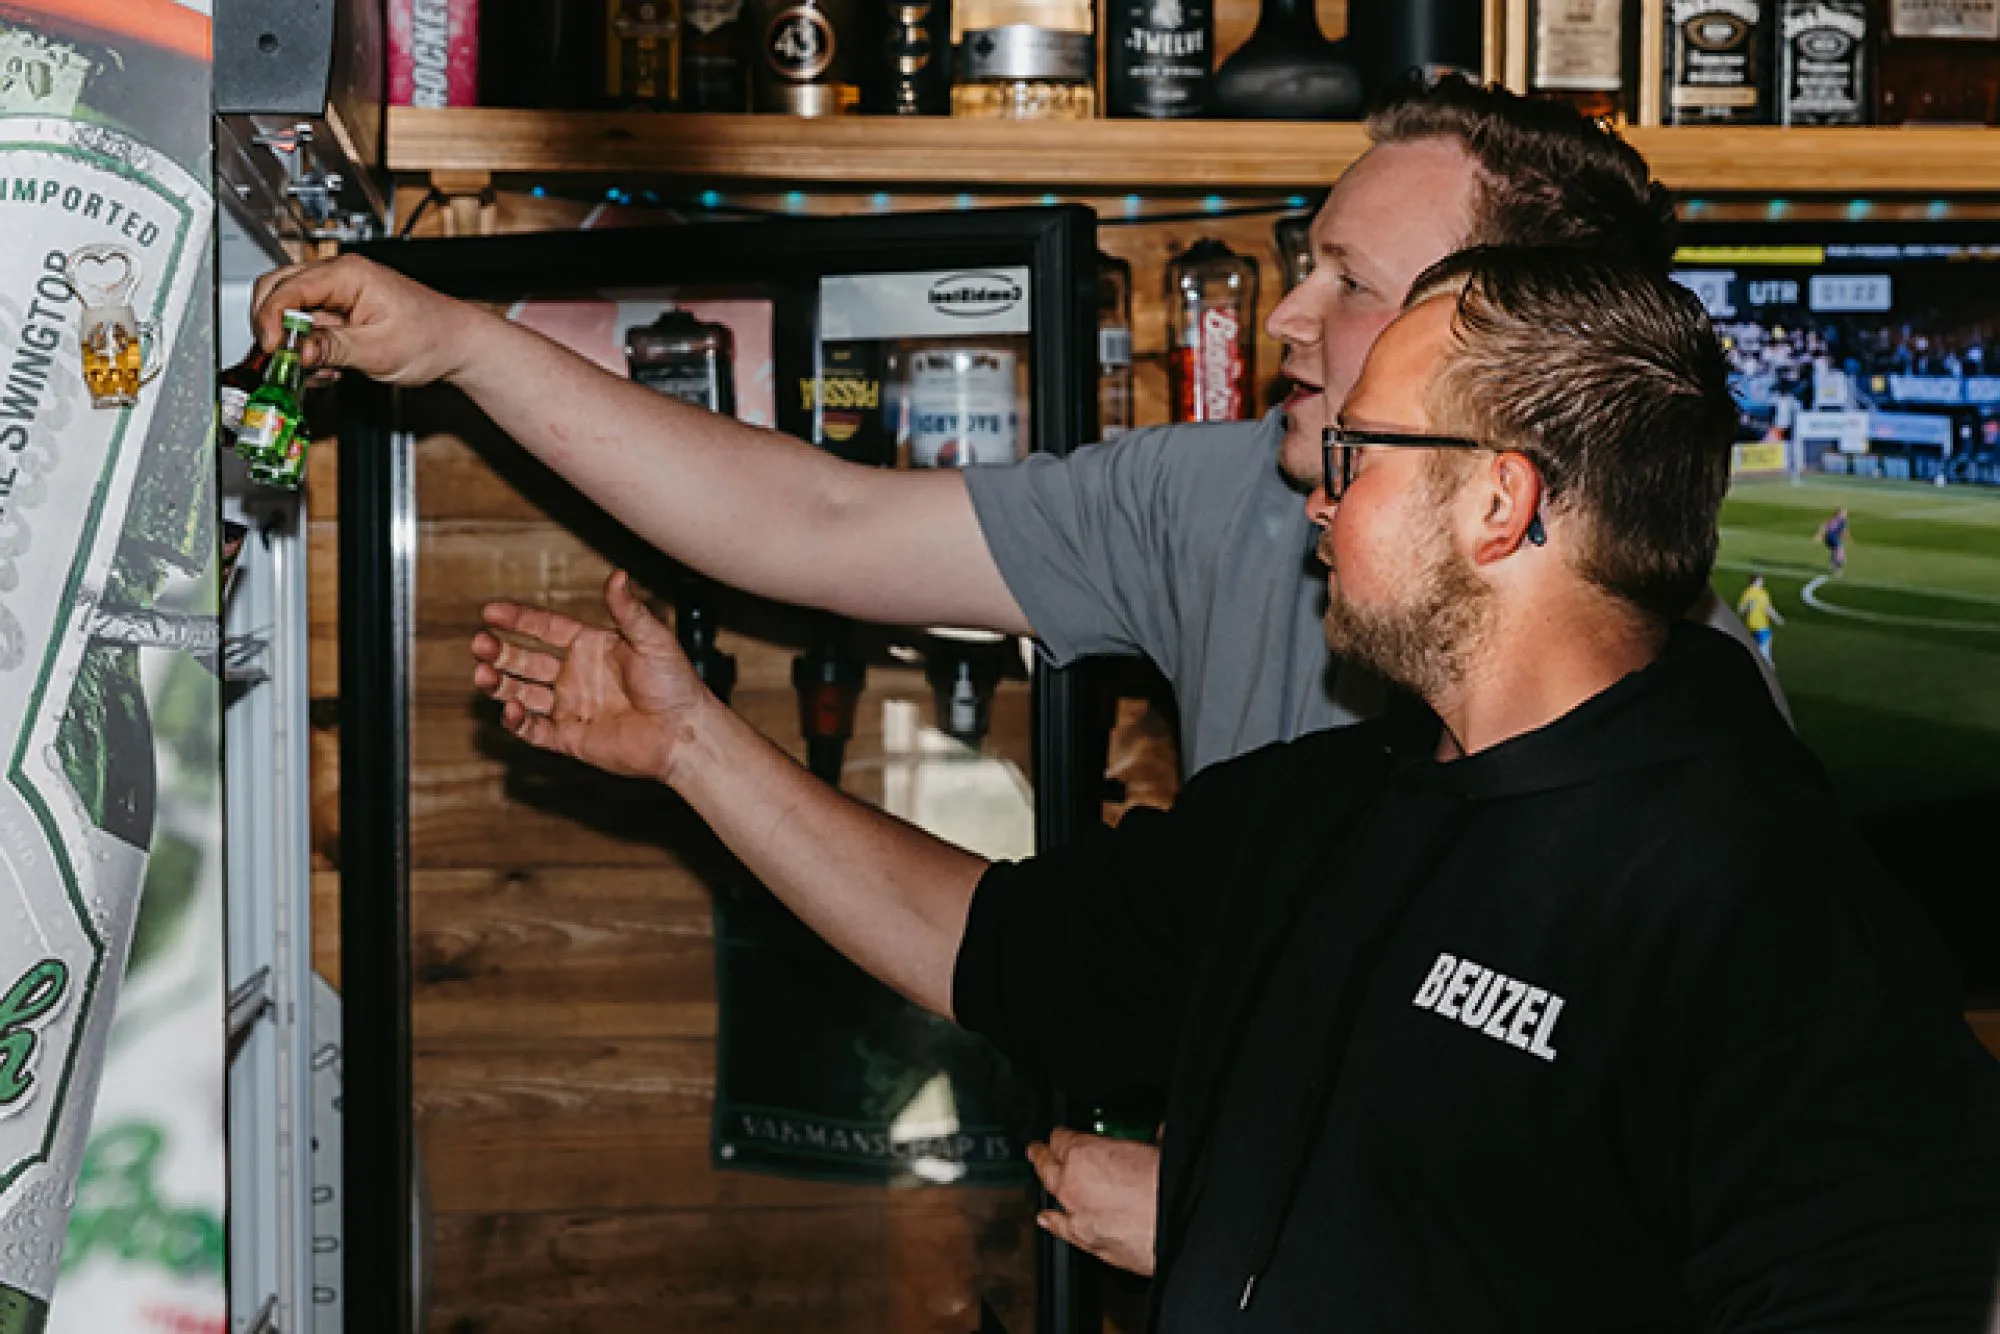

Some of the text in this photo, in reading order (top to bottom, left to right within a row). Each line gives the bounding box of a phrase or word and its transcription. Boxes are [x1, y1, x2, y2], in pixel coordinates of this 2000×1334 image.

[774, 19, 819, 59] 43
[0, 177, 160, 248] IMPORTED
[1411, 952, 1566, 1062] BEUZEL
